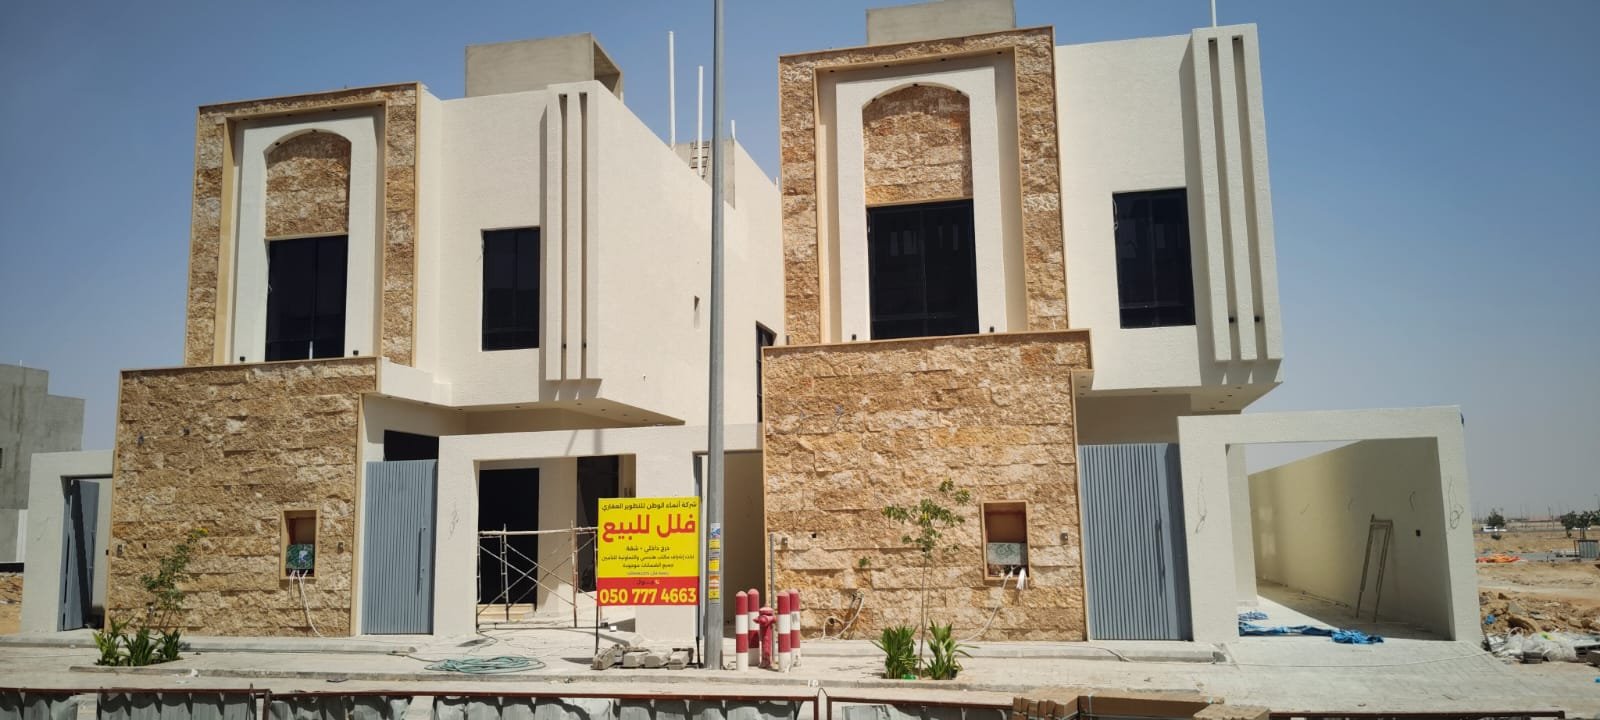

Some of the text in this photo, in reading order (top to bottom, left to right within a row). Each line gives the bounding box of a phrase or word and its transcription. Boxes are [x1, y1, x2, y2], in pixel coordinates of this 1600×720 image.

[602, 504, 624, 512] العقاري
[646, 502, 664, 510] الوطن
[682, 501, 696, 509] شركة
[602, 514, 650, 543] للبيع
[657, 513, 696, 538] فلل
[599, 588, 628, 604] 050
[632, 588, 658, 604] 777
[660, 587, 697, 604] 4663
